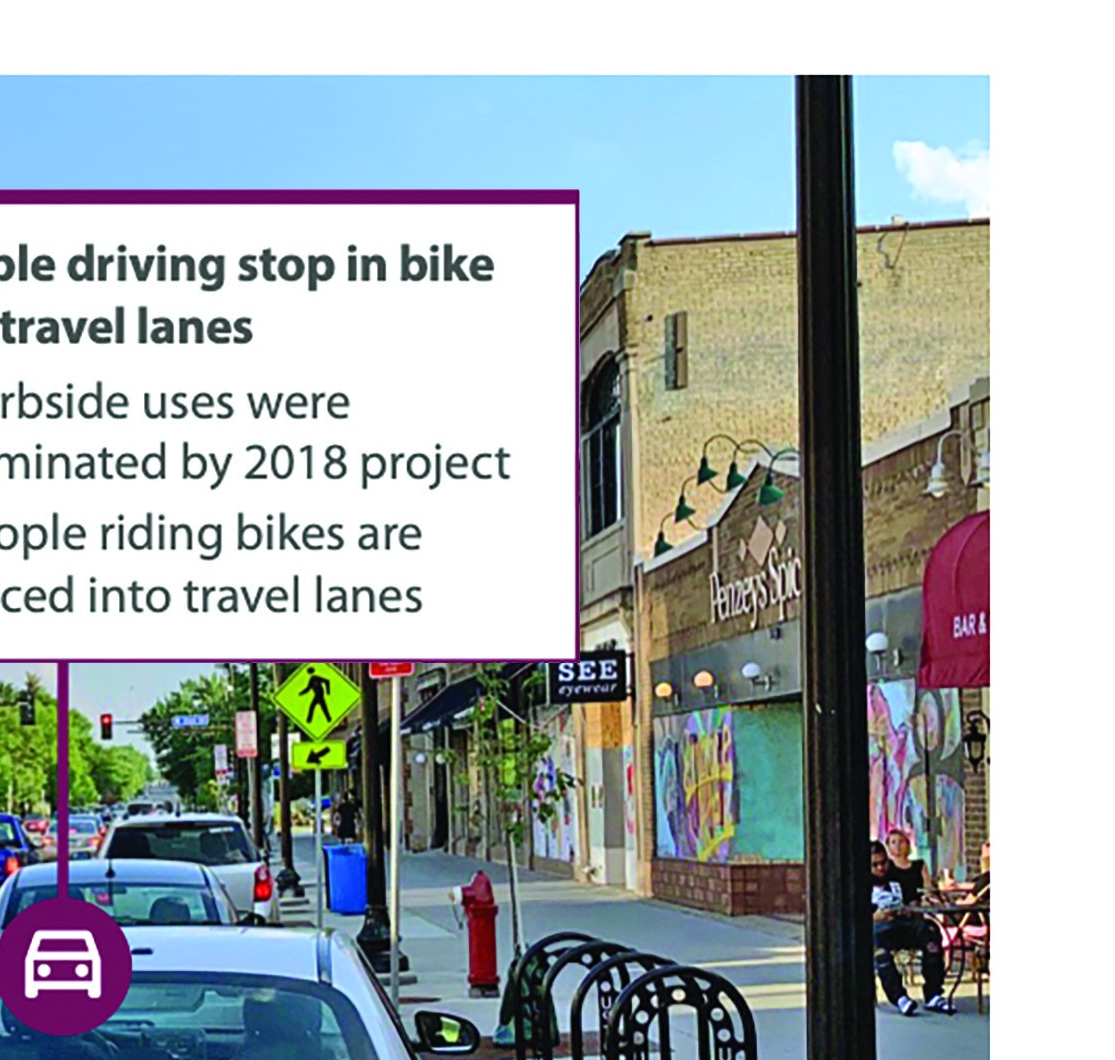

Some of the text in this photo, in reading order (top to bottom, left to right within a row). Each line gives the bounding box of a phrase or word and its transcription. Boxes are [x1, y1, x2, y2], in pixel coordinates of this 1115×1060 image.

[767, 546, 801, 622] Spic
[953, 611, 987, 639] BAR &
[558, 659, 618, 682] SEE
[558, 683, 618, 698] eyewear
